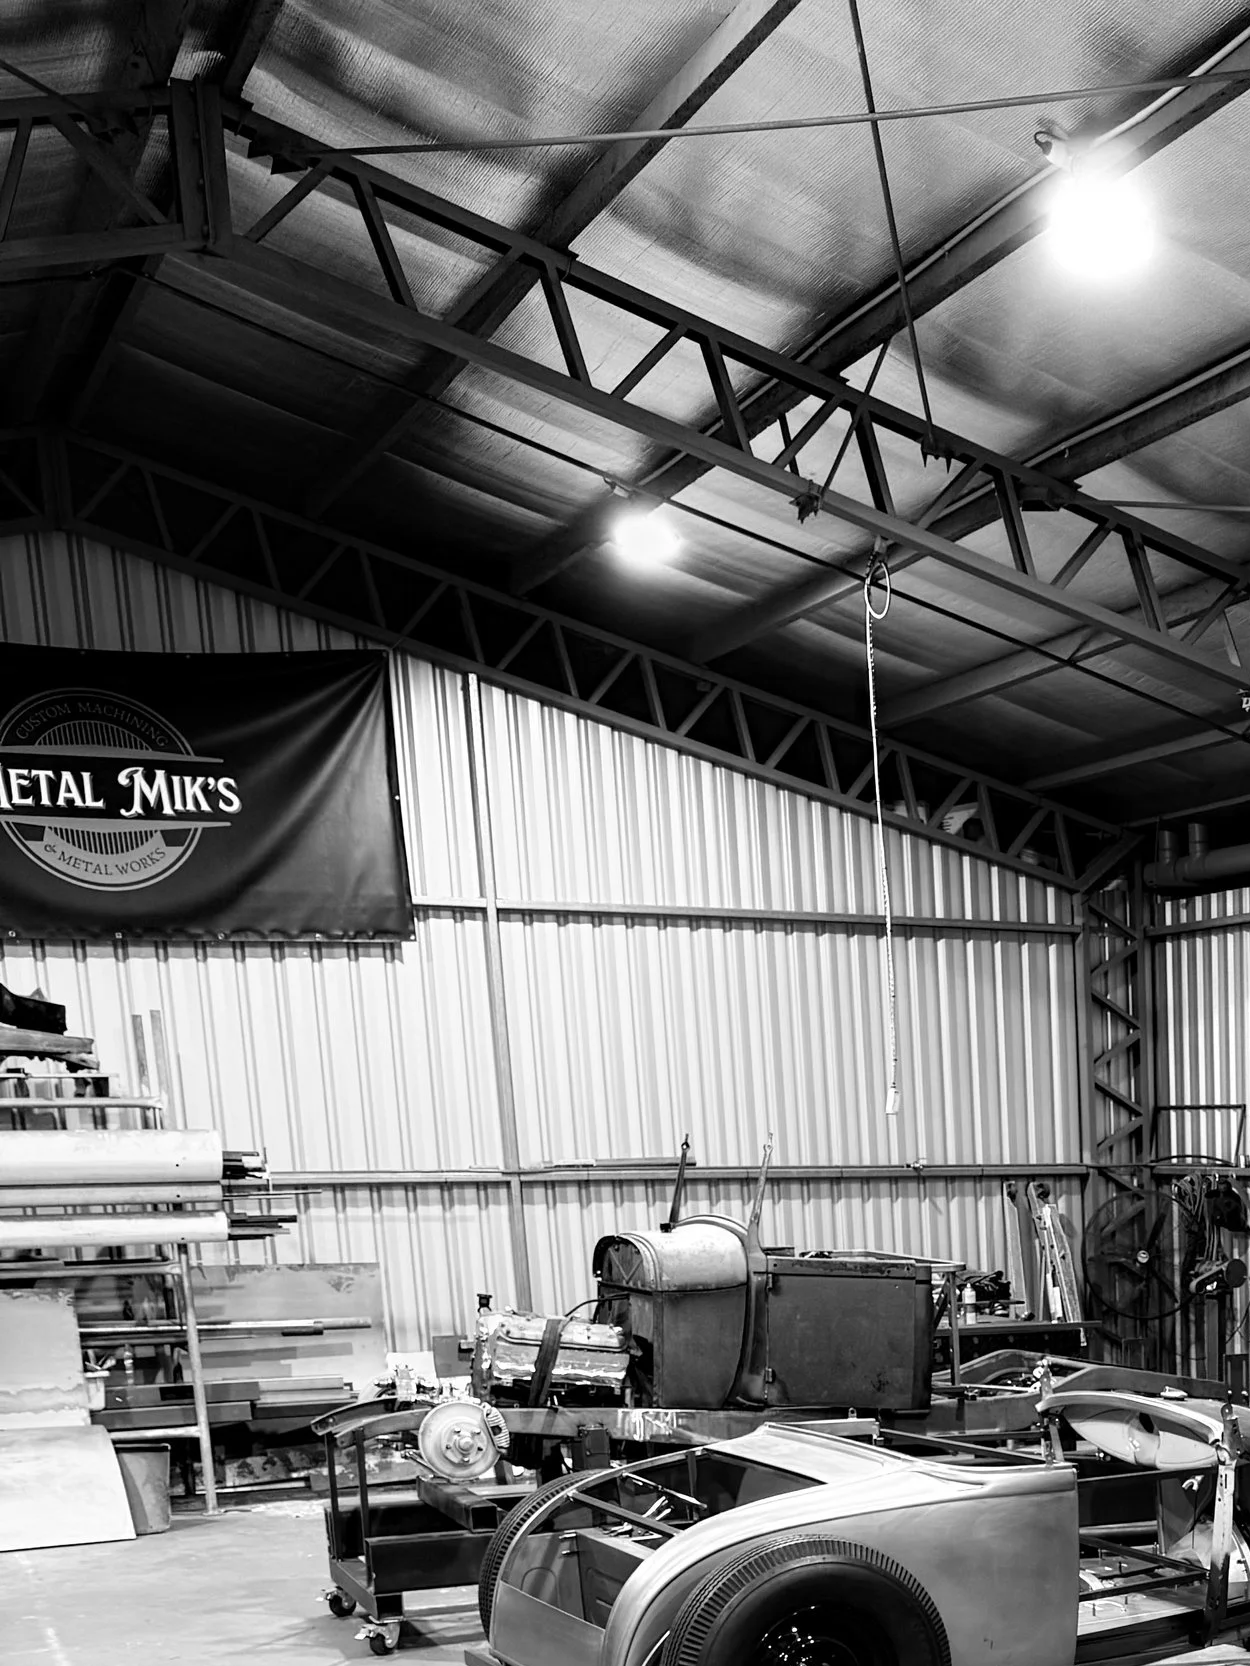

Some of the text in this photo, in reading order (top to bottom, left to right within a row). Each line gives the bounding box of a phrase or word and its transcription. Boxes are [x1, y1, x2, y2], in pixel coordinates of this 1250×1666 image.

[15, 701, 169, 748] CUSTOM MACHINING
[58, 850, 113, 876] METAL
[115, 846, 167, 876] WORKS
